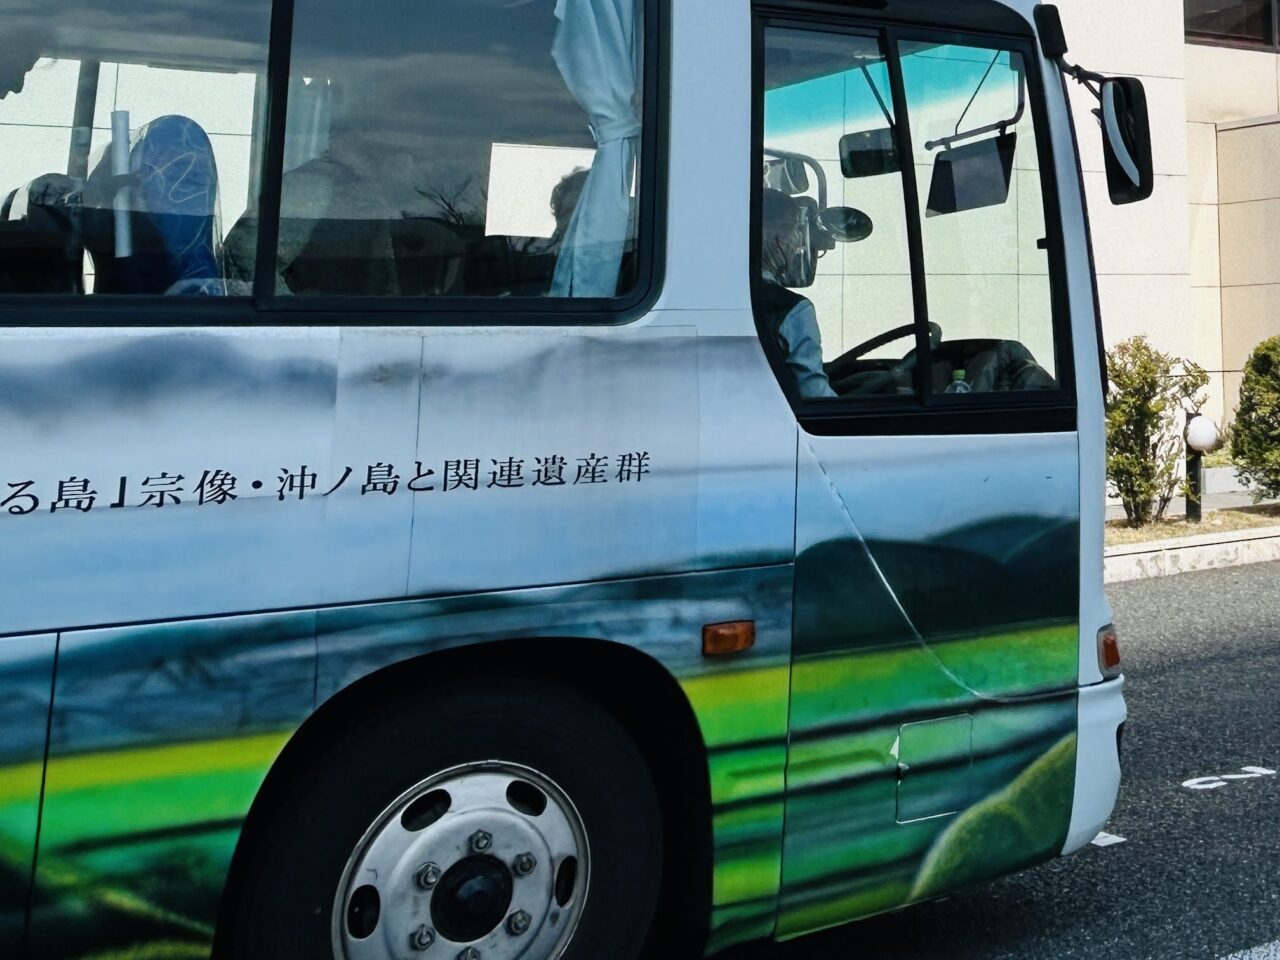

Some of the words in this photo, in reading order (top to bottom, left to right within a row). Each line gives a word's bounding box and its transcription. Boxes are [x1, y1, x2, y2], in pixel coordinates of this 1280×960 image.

[0, 451, 651, 515] る島」宗像・沖ノ島と関連遺産群
